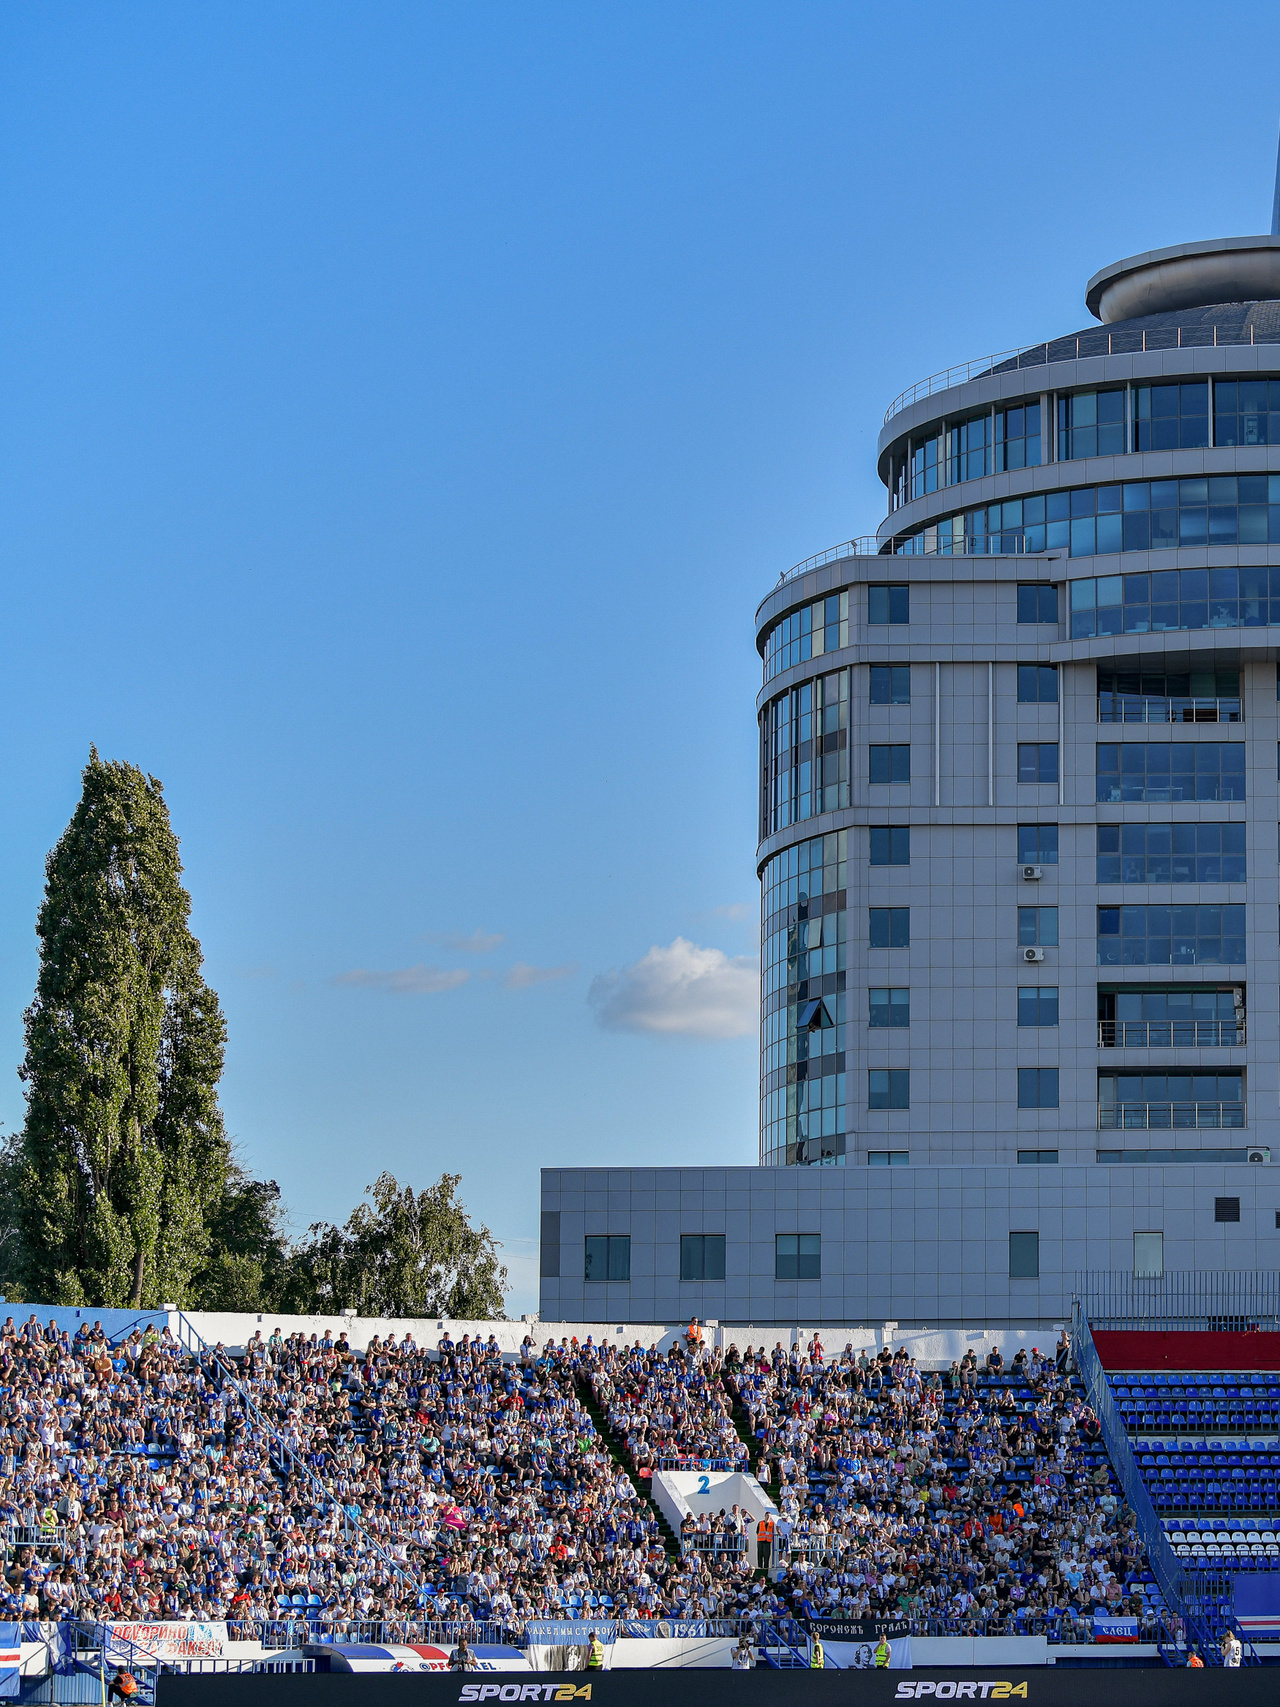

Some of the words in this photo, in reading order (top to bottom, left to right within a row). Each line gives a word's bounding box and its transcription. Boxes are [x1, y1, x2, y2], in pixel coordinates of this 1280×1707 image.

[697, 1475, 710, 1495] 2
[458, 1683, 592, 1702] SPORT24
[894, 1681, 1028, 1699] SPORT24
